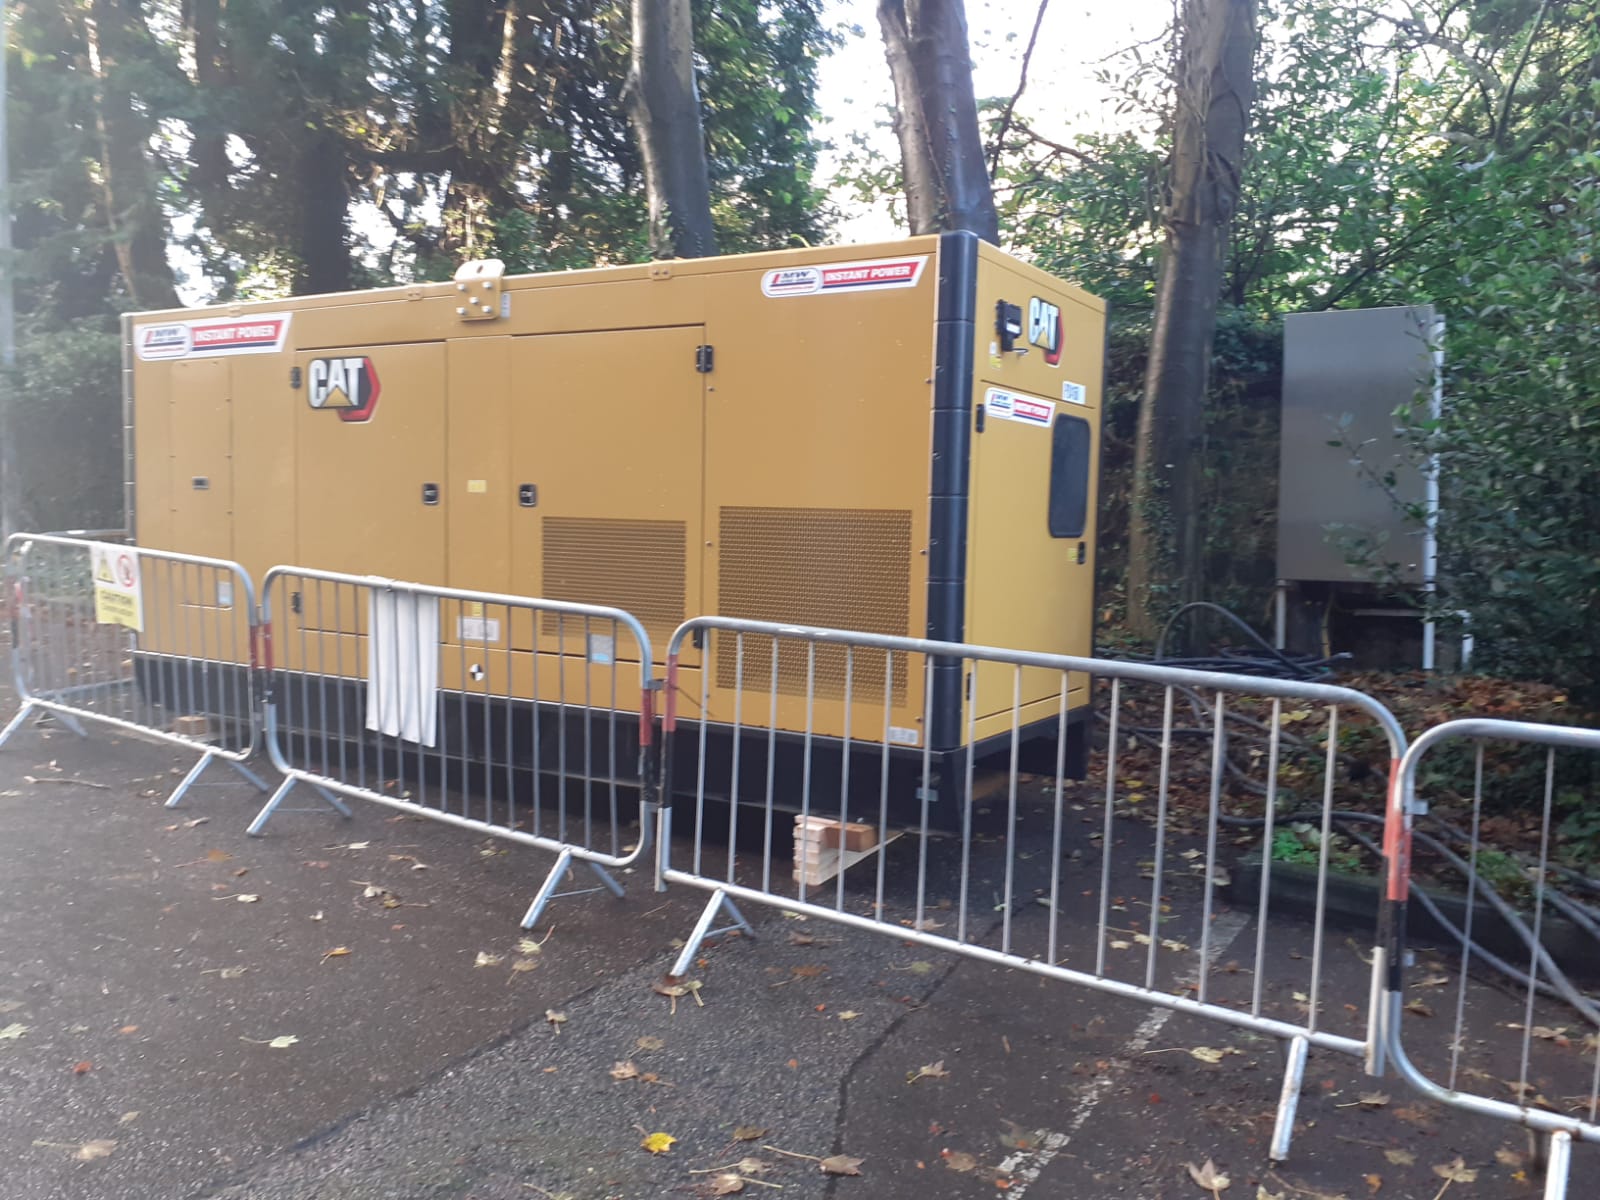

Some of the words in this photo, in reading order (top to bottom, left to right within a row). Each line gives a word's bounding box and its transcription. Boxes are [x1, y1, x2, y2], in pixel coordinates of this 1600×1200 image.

[824, 269, 870, 282] INSTANT
[871, 265, 911, 278] POWER
[237, 325, 276, 338] POWER
[1029, 296, 1059, 351] CAT
[308, 357, 364, 408] CAT
